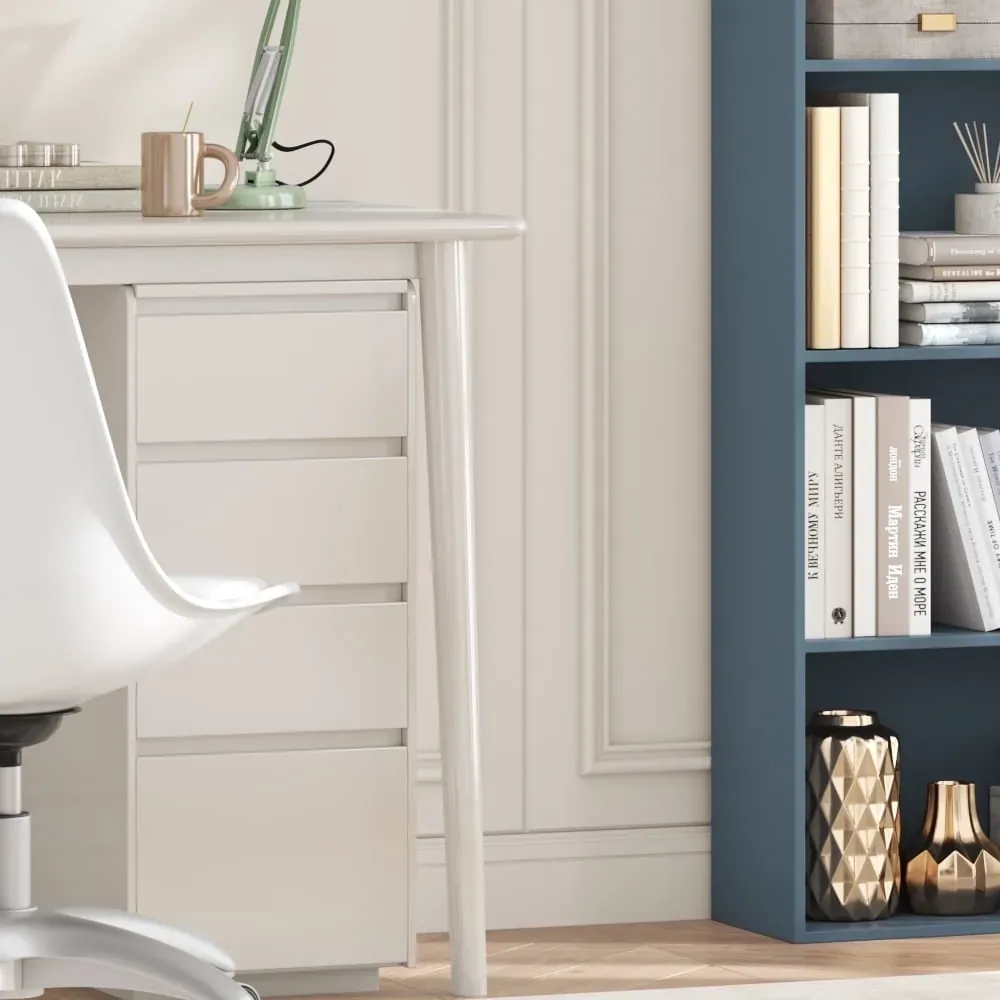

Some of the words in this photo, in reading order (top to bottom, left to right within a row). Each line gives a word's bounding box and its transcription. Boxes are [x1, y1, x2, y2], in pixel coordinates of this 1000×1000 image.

[832, 424, 844, 461] ДАНТЕ
[808, 471, 819, 507] МИРУ
[834, 463, 844, 519] АЛИГЬЕРИ
[885, 505, 903, 558] Мартин
[913, 491, 927, 548] РАССКАЖИ
[986, 518, 996, 537] TIME
[808, 512, 819, 568] ВЕЧНОМУ
[991, 539, 999, 550] OF
[808, 572, 819, 580] К
[913, 551, 927, 573] МНЕ
[885, 564, 903, 599] Иден
[913, 587, 927, 616] МОРЕ
